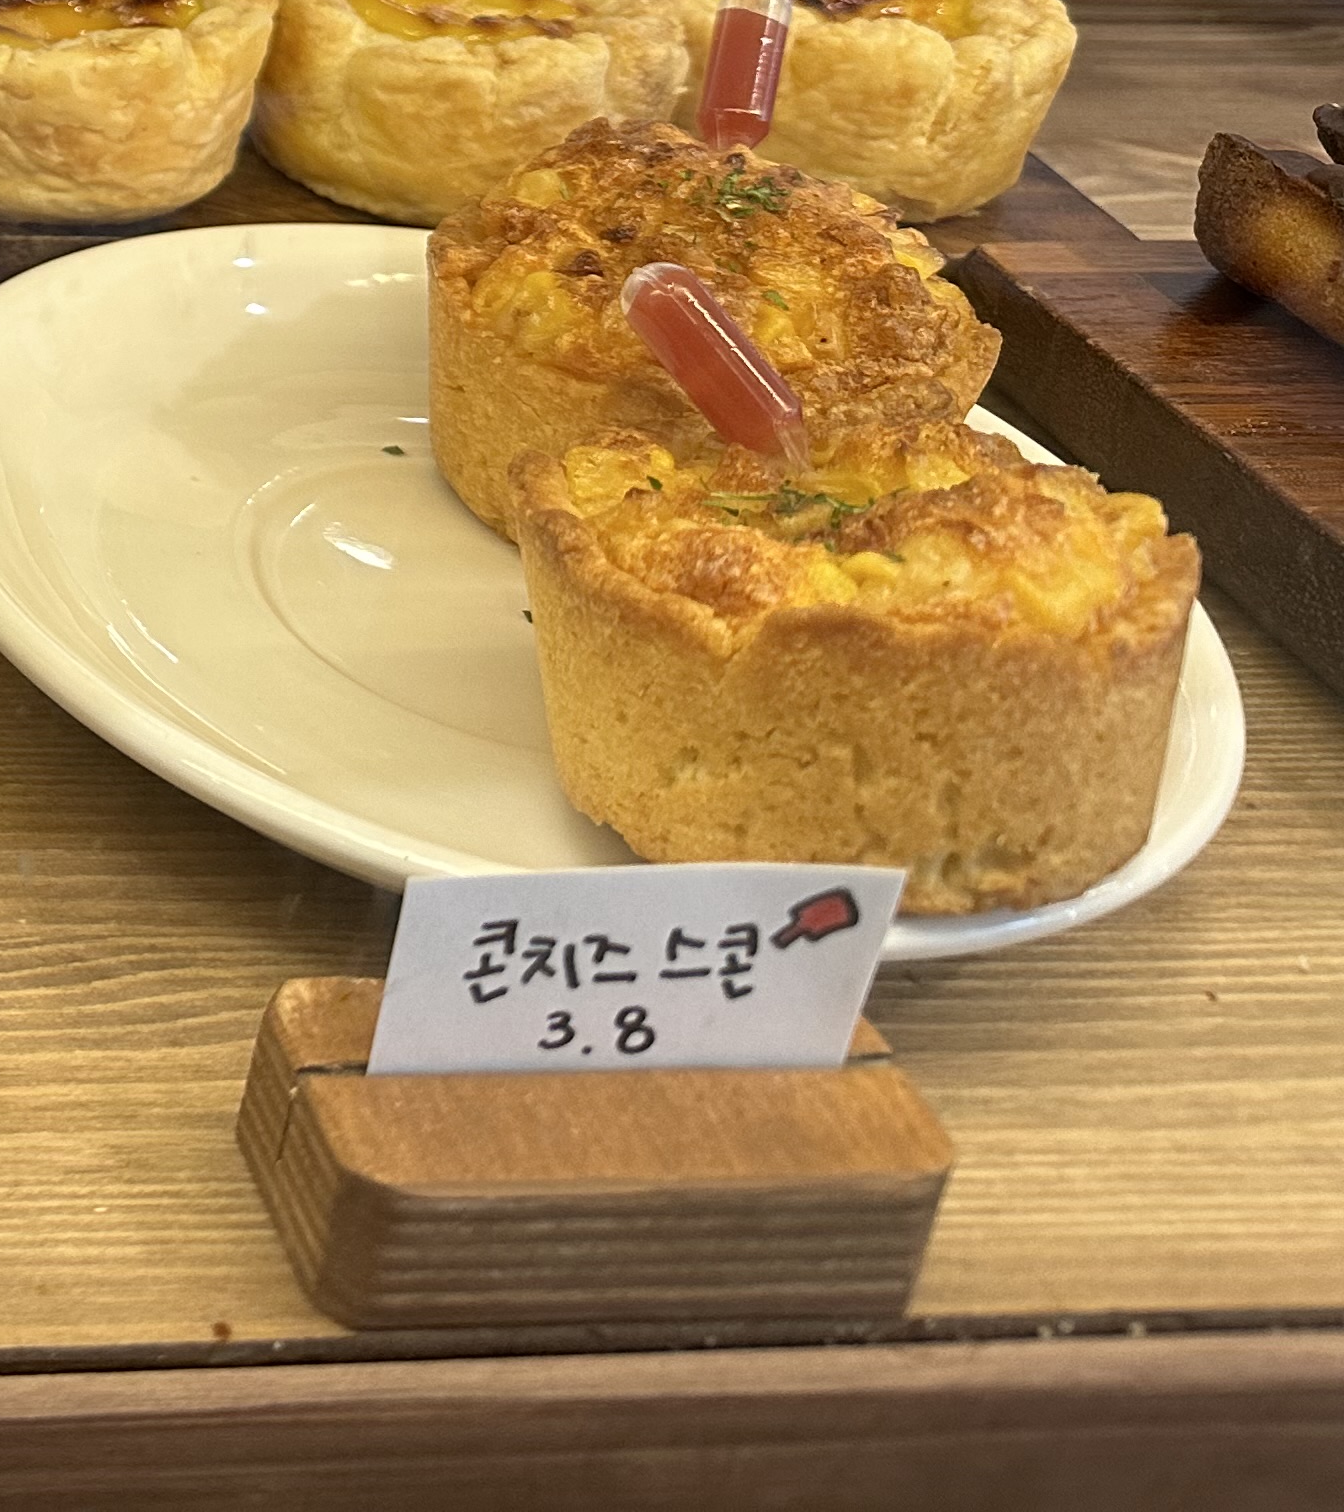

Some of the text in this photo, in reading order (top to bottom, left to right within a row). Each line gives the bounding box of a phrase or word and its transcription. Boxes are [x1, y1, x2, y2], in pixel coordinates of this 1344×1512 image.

[463, 919, 760, 1004] 콘치즈 스콘
[538, 1005, 656, 1056] 3.8
